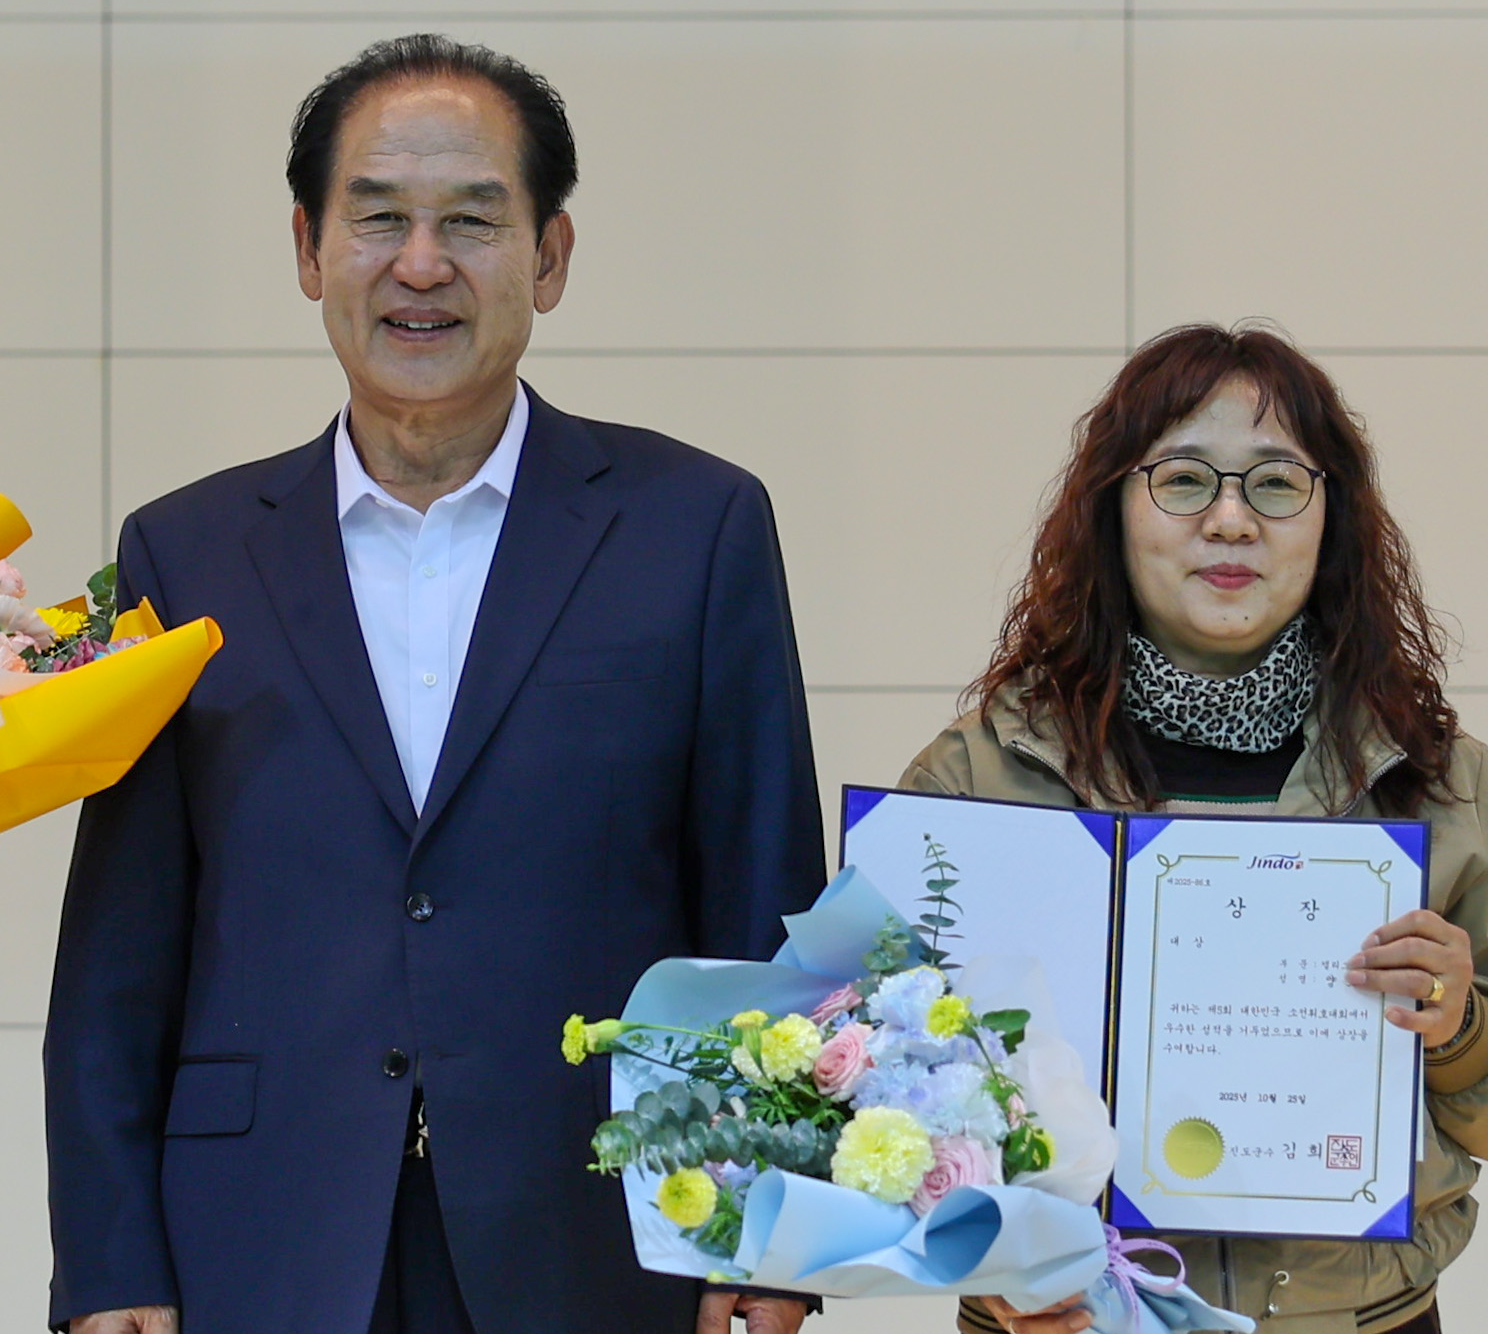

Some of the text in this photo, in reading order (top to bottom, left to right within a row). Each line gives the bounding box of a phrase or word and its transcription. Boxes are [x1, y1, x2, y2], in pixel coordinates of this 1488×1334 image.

[1247, 853, 1299, 869] Jindo
[1225, 896, 1320, 921] 상 장
[1219, 1092, 1306, 1104] 2025년 10월 25일
[1283, 1141, 1296, 1159] 김
